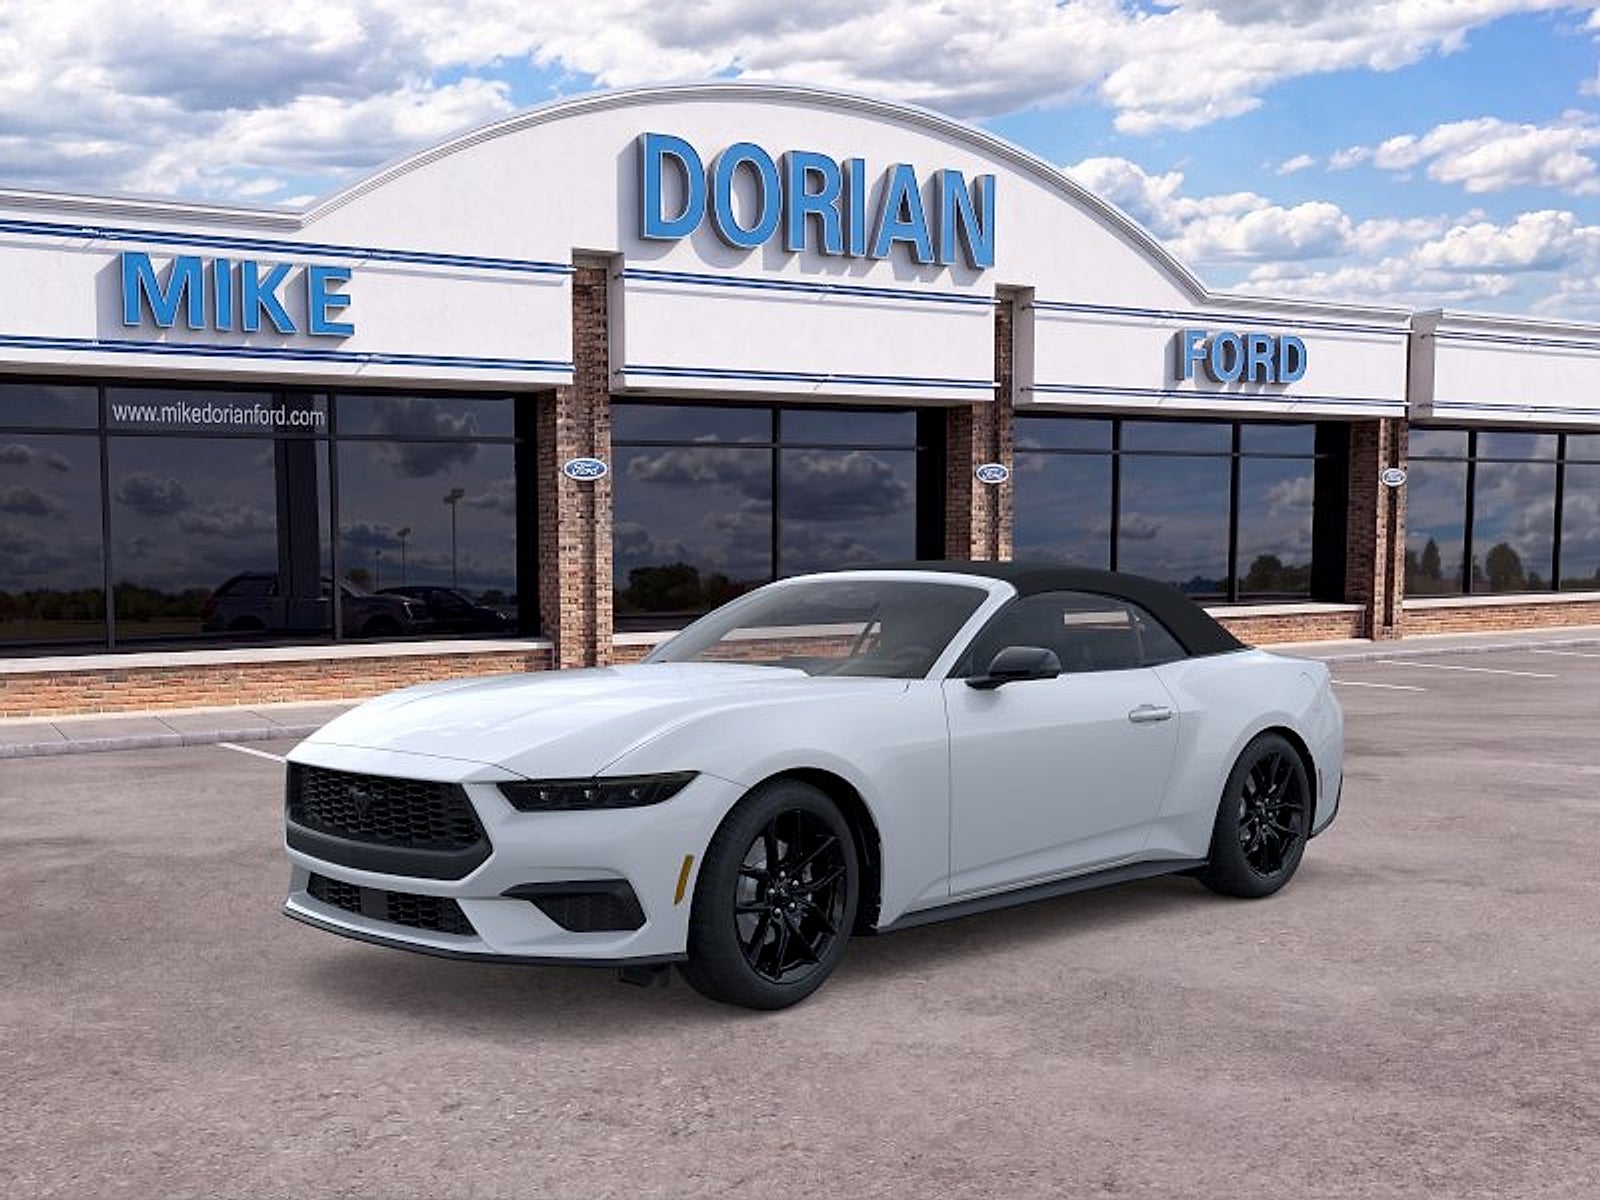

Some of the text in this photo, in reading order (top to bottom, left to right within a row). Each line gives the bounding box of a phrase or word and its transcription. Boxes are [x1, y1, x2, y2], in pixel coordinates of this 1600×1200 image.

[640, 132, 996, 270] DORIAN
[121, 251, 355, 338] MIKE
[1175, 328, 1308, 384] FORD
[112, 402, 325, 426] www.mikedorianford.com
